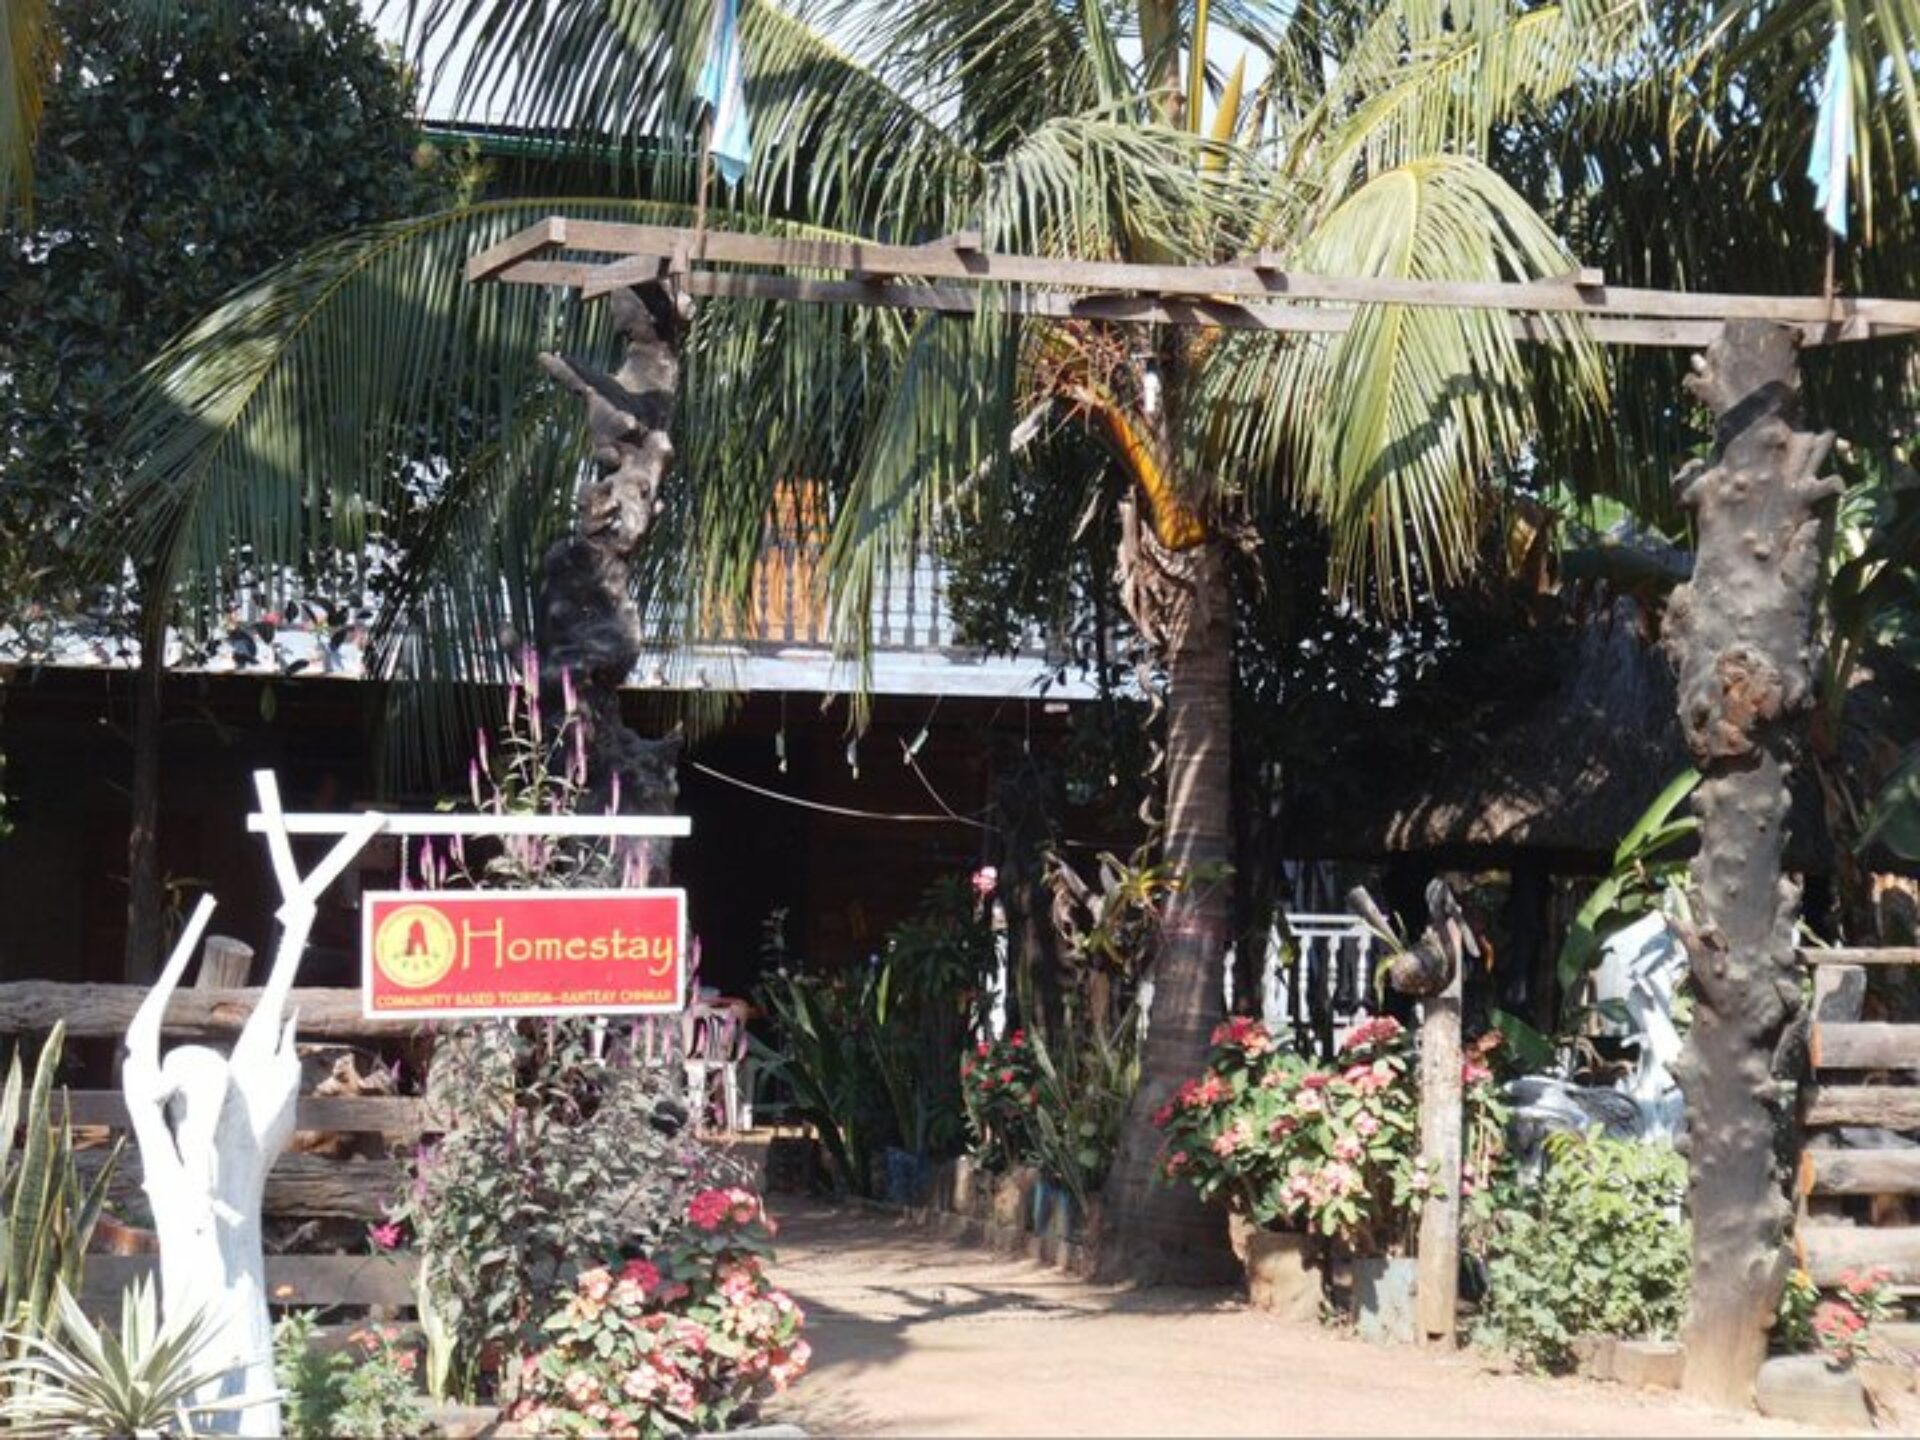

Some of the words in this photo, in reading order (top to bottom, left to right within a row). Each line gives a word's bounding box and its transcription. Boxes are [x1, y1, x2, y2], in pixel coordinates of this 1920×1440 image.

[461, 917, 674, 977] Homestay
[376, 993, 453, 1007] COMMUNITY
[455, 991, 496, 1006] BASED
